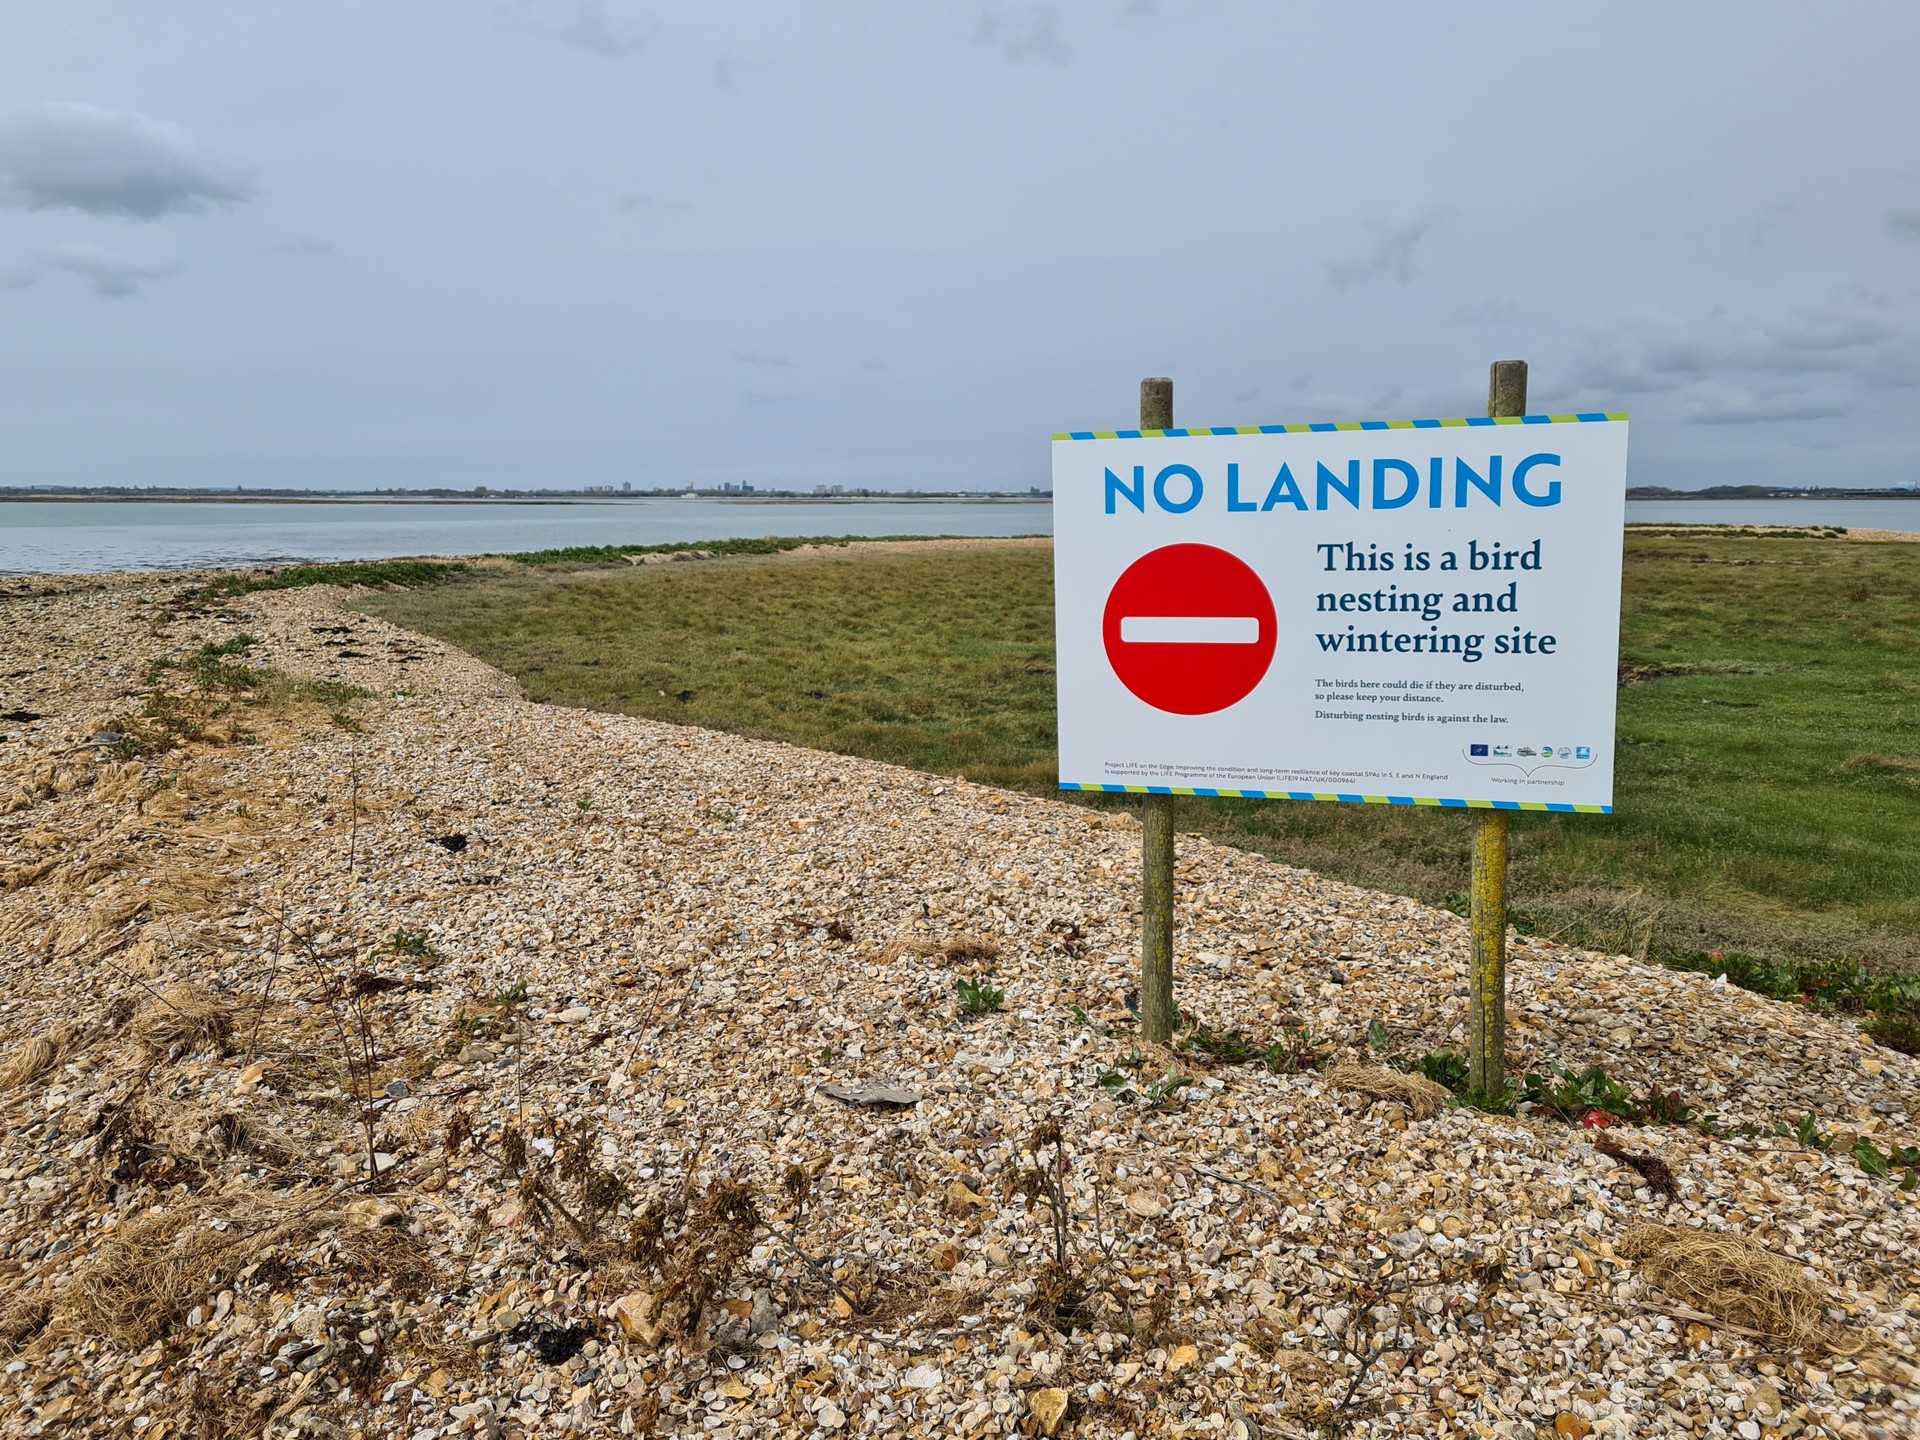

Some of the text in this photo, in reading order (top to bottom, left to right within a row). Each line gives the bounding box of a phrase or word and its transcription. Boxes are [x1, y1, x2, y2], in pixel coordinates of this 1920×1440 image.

[1105, 453, 1562, 514] NO LANDING
[1317, 539, 1542, 571] This is a bird
[1316, 582, 1518, 621] nesting and
[1315, 626, 1556, 662] wintering site
[1315, 679, 1333, 687] The
[1335, 679, 1358, 688] birds
[1360, 680, 1380, 688] here
[1382, 680, 1407, 689] could
[1409, 680, 1424, 689] die
[1426, 680, 1433, 689] if
[1435, 681, 1456, 692] they
[1475, 682, 1524, 692] disturbed,
[1327, 692, 1354, 702] please
[1356, 692, 1378, 703] keep
[1379, 695, 1401, 703] your
[1402, 693, 1444, 702] distance.
[1315, 710, 1508, 724] Disturbing nesting birds is against the law.
[1104, 761, 1125, 769] Project
[1159, 763, 1175, 771] Edge:
[1259, 767, 1290, 775] long-term
[1491, 777, 1518, 785] Working
